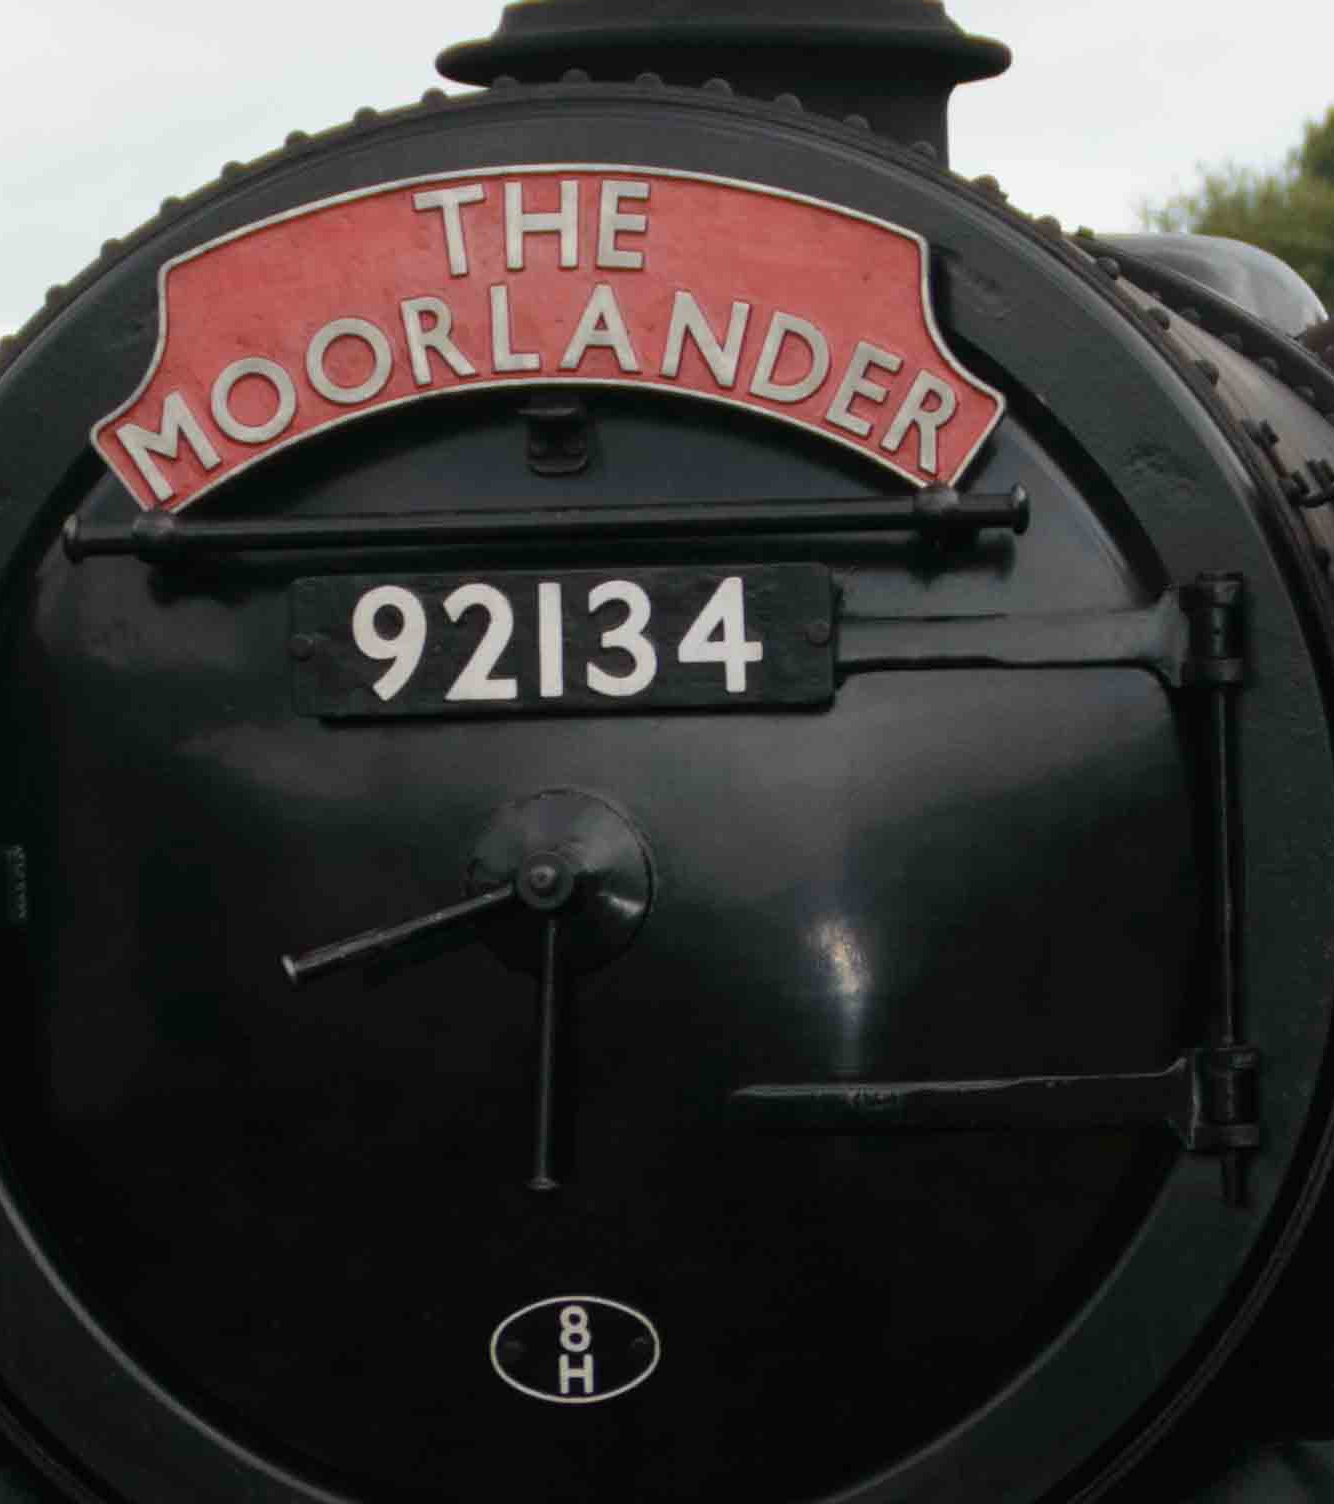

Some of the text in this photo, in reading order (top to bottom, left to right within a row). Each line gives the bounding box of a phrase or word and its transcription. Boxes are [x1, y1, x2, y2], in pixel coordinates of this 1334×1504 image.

[413, 179, 650, 276] THE
[116, 283, 956, 501] MOORLANDER
[351, 576, 764, 702] 92134
[559, 1304, 591, 1353] 8
[559, 1353, 594, 1394] H
